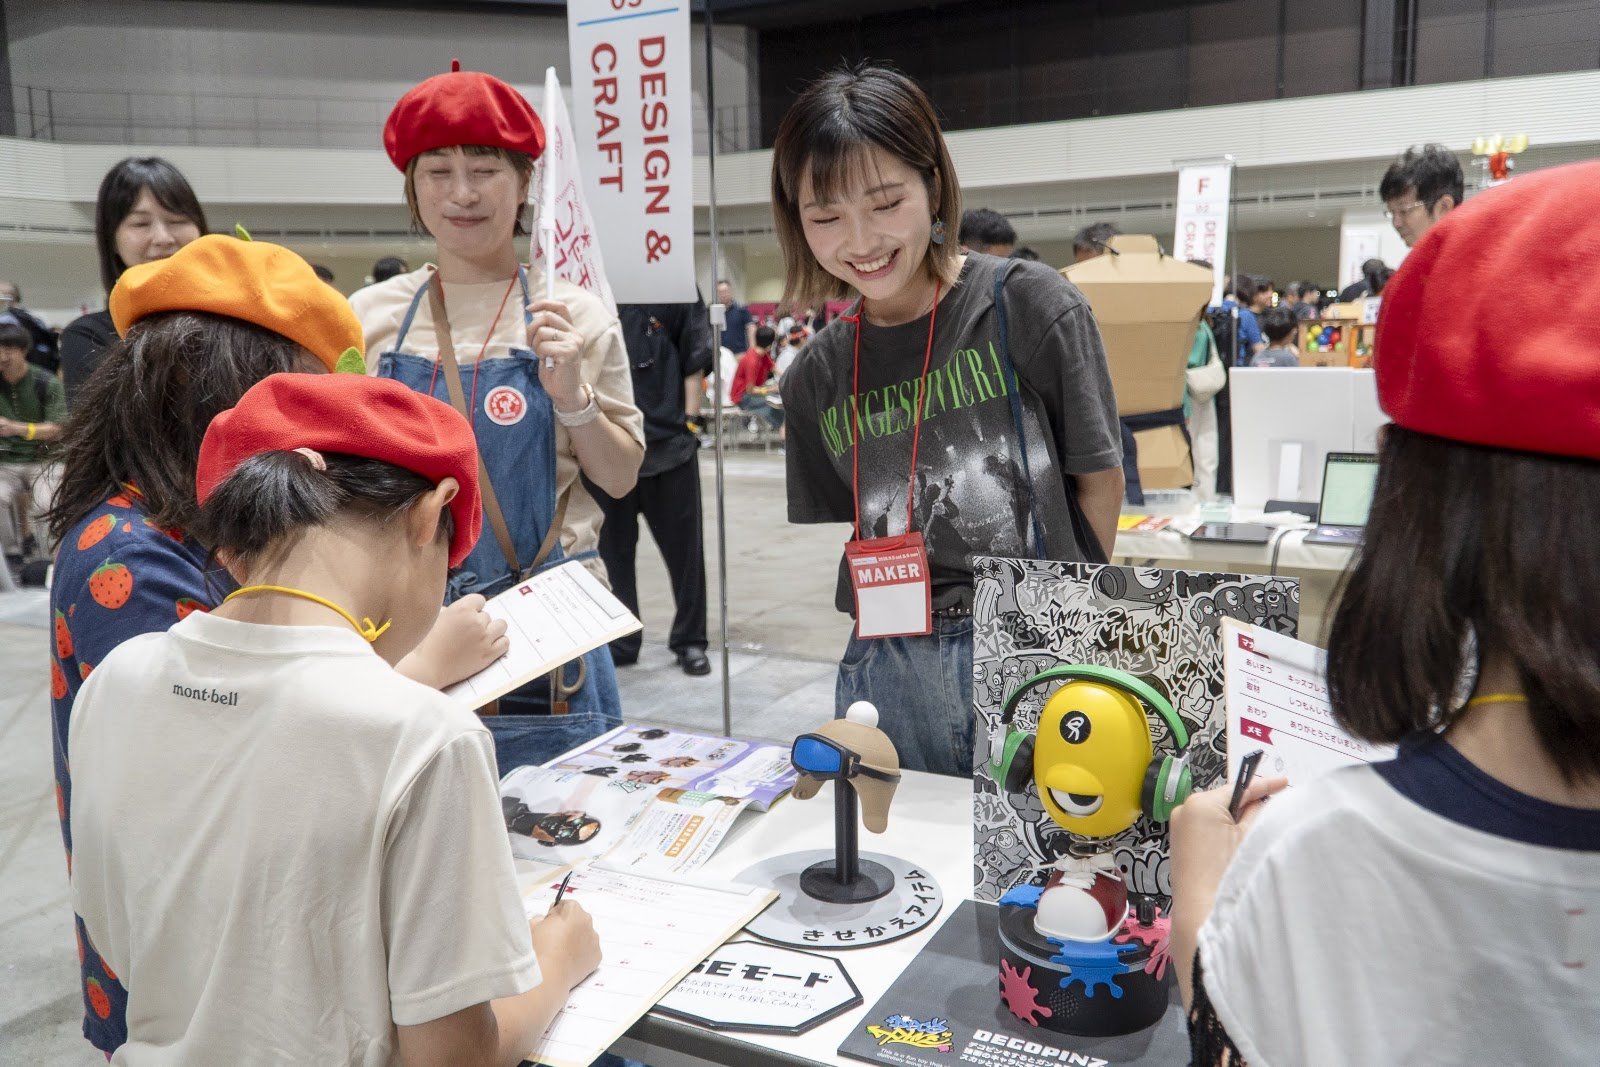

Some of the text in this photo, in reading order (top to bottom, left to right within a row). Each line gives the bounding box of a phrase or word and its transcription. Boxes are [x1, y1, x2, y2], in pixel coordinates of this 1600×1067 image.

[590, 43, 624, 193] CRAFT
[638, 36, 672, 264] DESIGN &
[858, 563, 920, 584] MAKER
[1247, 726, 1262, 737] メモ
[972, 1028, 1109, 1067] DECOPINZ
